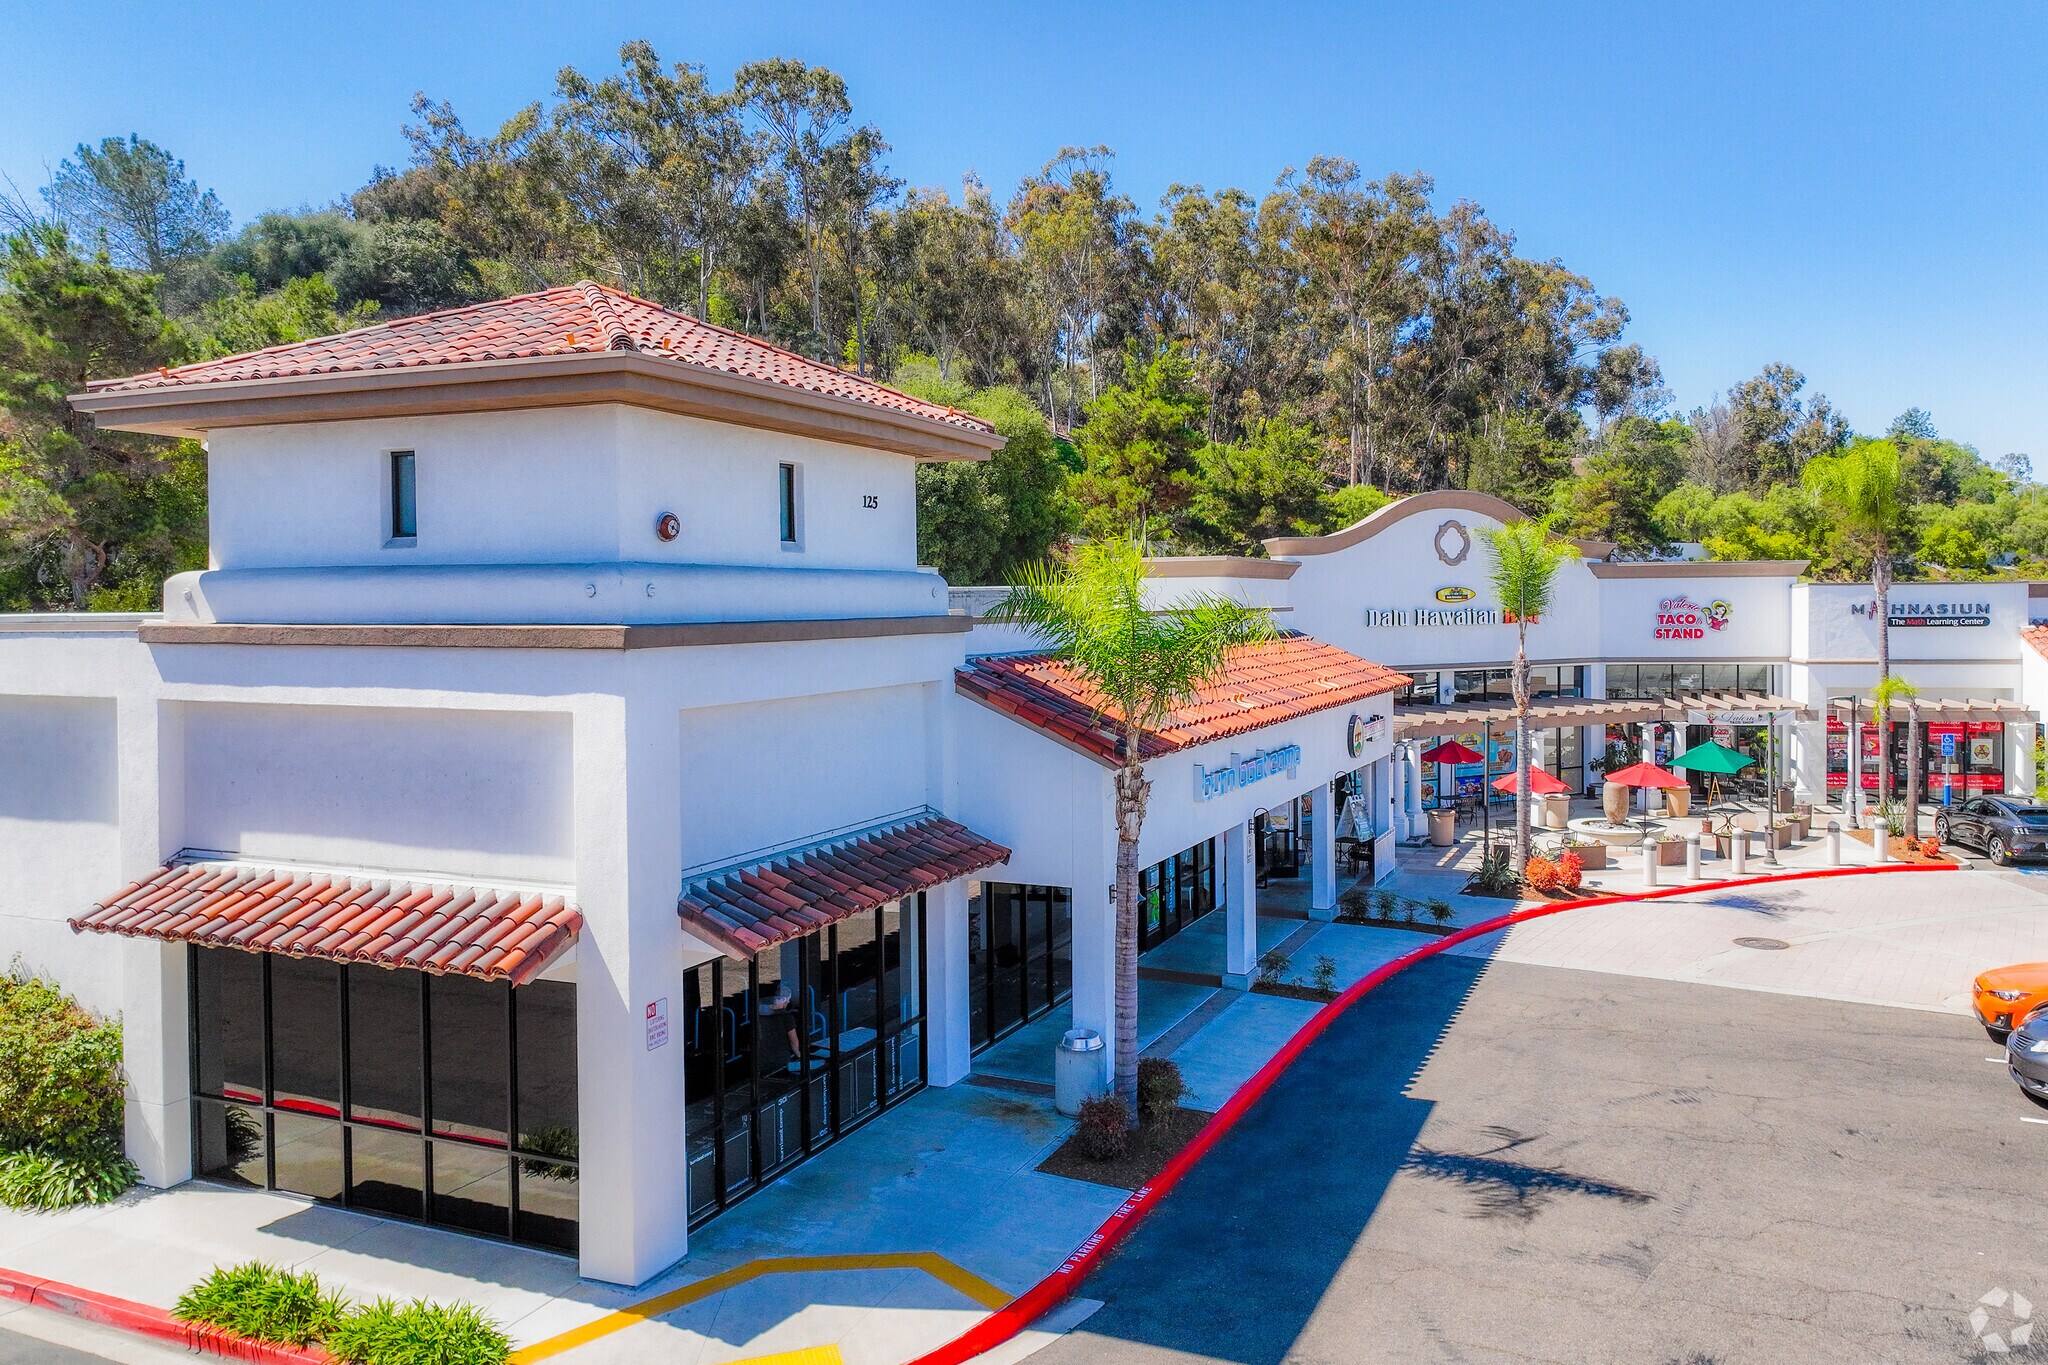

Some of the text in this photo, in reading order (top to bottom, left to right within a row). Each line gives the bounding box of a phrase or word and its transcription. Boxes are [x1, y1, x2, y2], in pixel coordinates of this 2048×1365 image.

[862, 495, 878, 509] 125
[1415, 608, 1498, 626] Hawaiian
[1851, 600, 1990, 620] MAHNASIUM
[1657, 614, 1697, 625] TACO
[1891, 618, 1985, 627] The Math Learning Center
[1655, 628, 1705, 639] STAND
[1201, 745, 1301, 803] burn boot camp
[647, 1003, 656, 1018] NO
[1058, 1186, 1153, 1275] NO PARKING FIRE LANE
